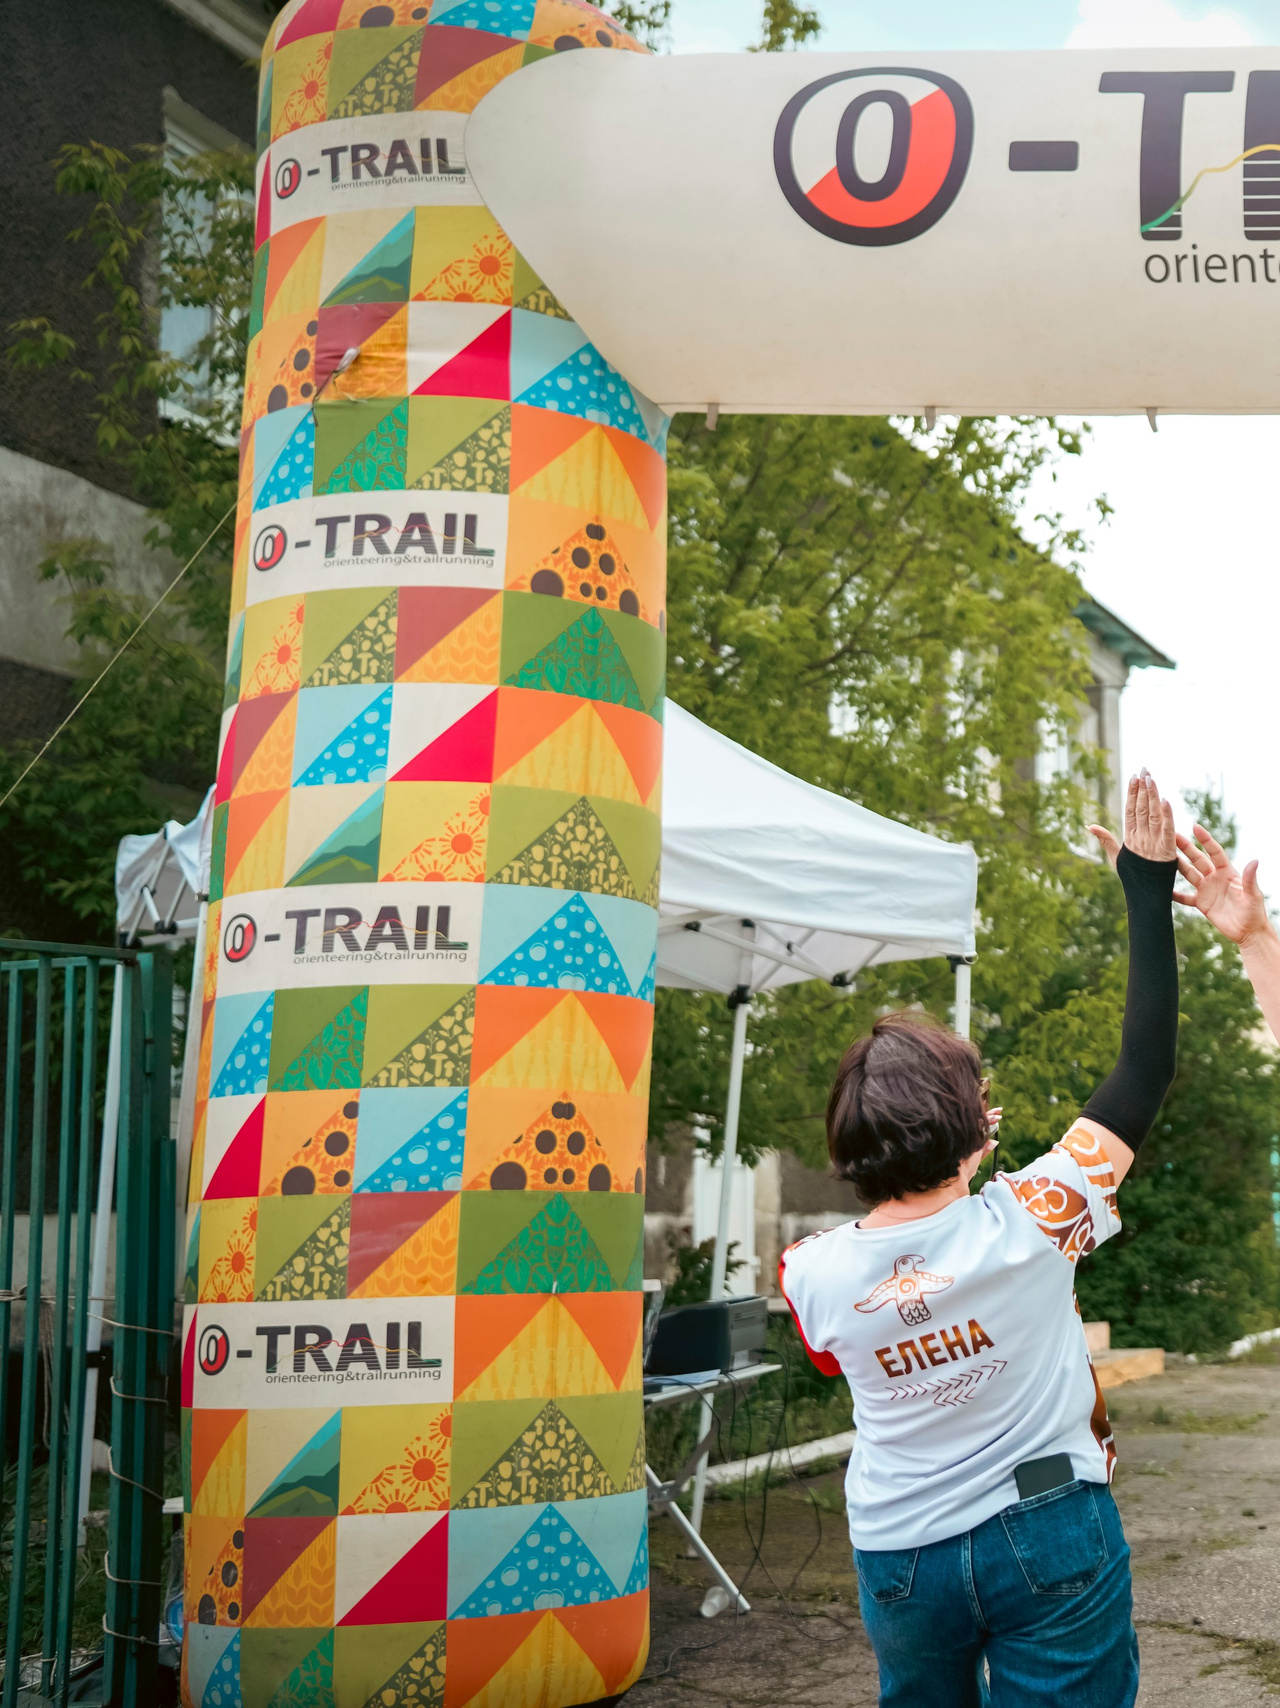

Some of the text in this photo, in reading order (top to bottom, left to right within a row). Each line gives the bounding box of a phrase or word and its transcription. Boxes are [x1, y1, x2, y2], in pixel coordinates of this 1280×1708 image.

[331, 172, 466, 191] orienteering&trailrunning
[324, 553, 494, 568] orienteering&trailrunning
[294, 949, 467, 964] orienteering&trailrunning
[874, 1318, 995, 1379] ЕЛЕНА
[266, 1368, 442, 1384] orienteering&trailrunning
